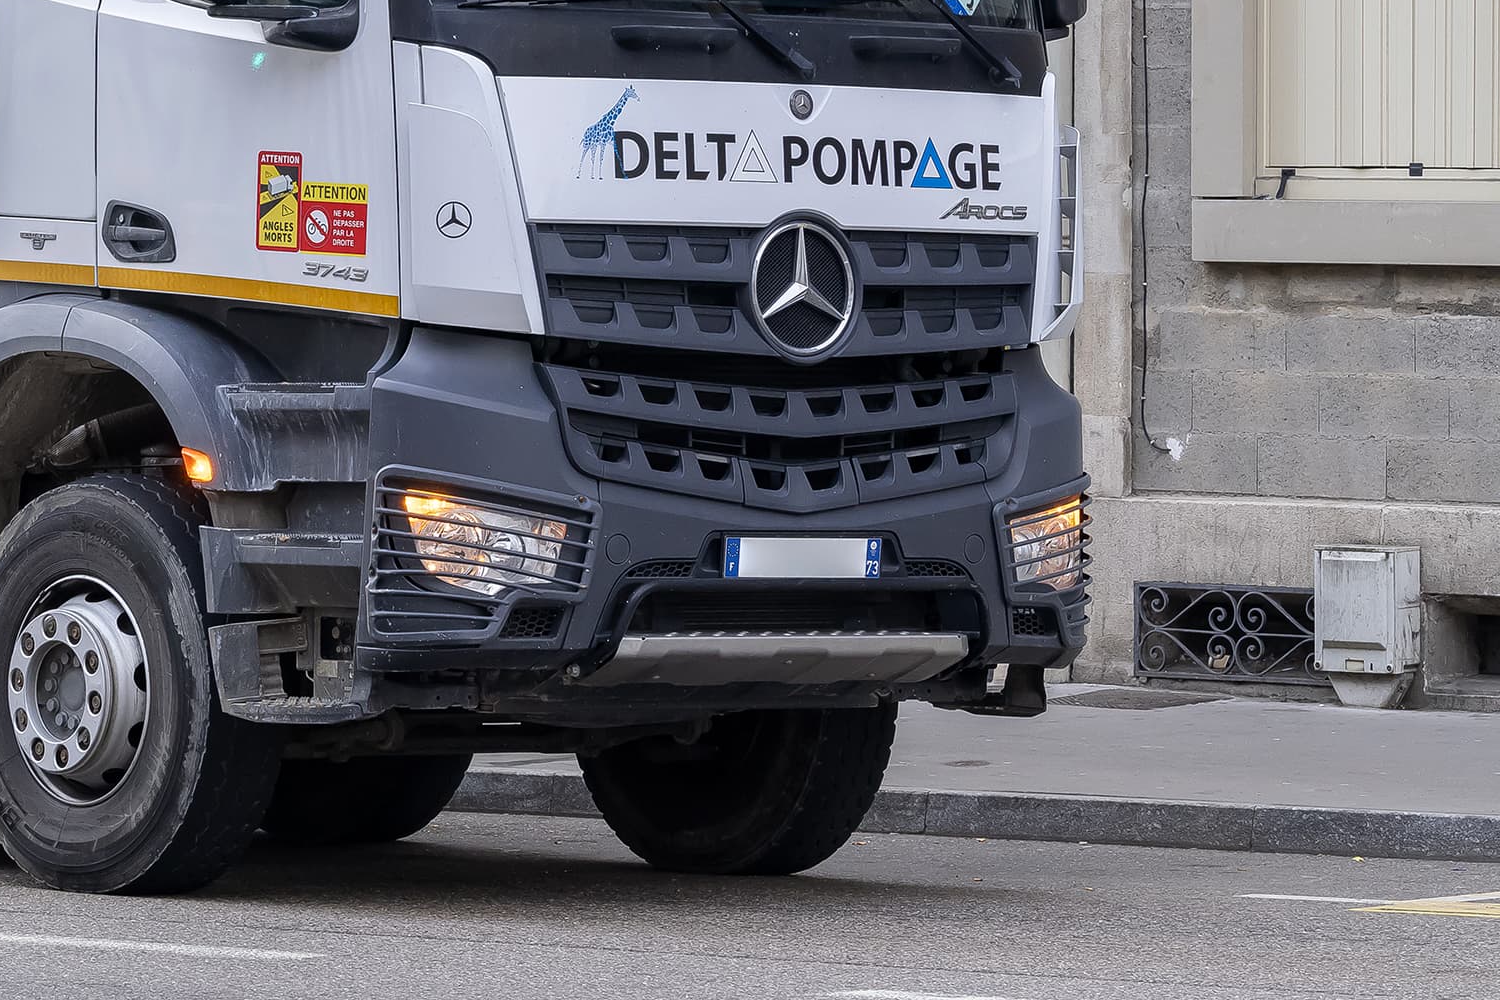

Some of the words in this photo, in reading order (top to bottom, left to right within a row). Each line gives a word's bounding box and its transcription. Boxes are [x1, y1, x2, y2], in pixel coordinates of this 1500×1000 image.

[260, 153, 300, 164] ATTENTION
[783, 136, 1002, 191] POMPAGE
[303, 184, 366, 201] ATTENTION
[333, 209, 342, 218] NE
[342, 210, 355, 218] PAS
[263, 220, 294, 232] ANGLES
[332, 219, 365, 229] DEPASSER
[264, 232, 293, 243] MORTS
[332, 228, 345, 237] PAR
[345, 229, 355, 238] LA
[332, 238, 355, 248] DROITE
[302, 261, 369, 283] 3743
[729, 562, 735, 572] F
[866, 560, 879, 575] 73
